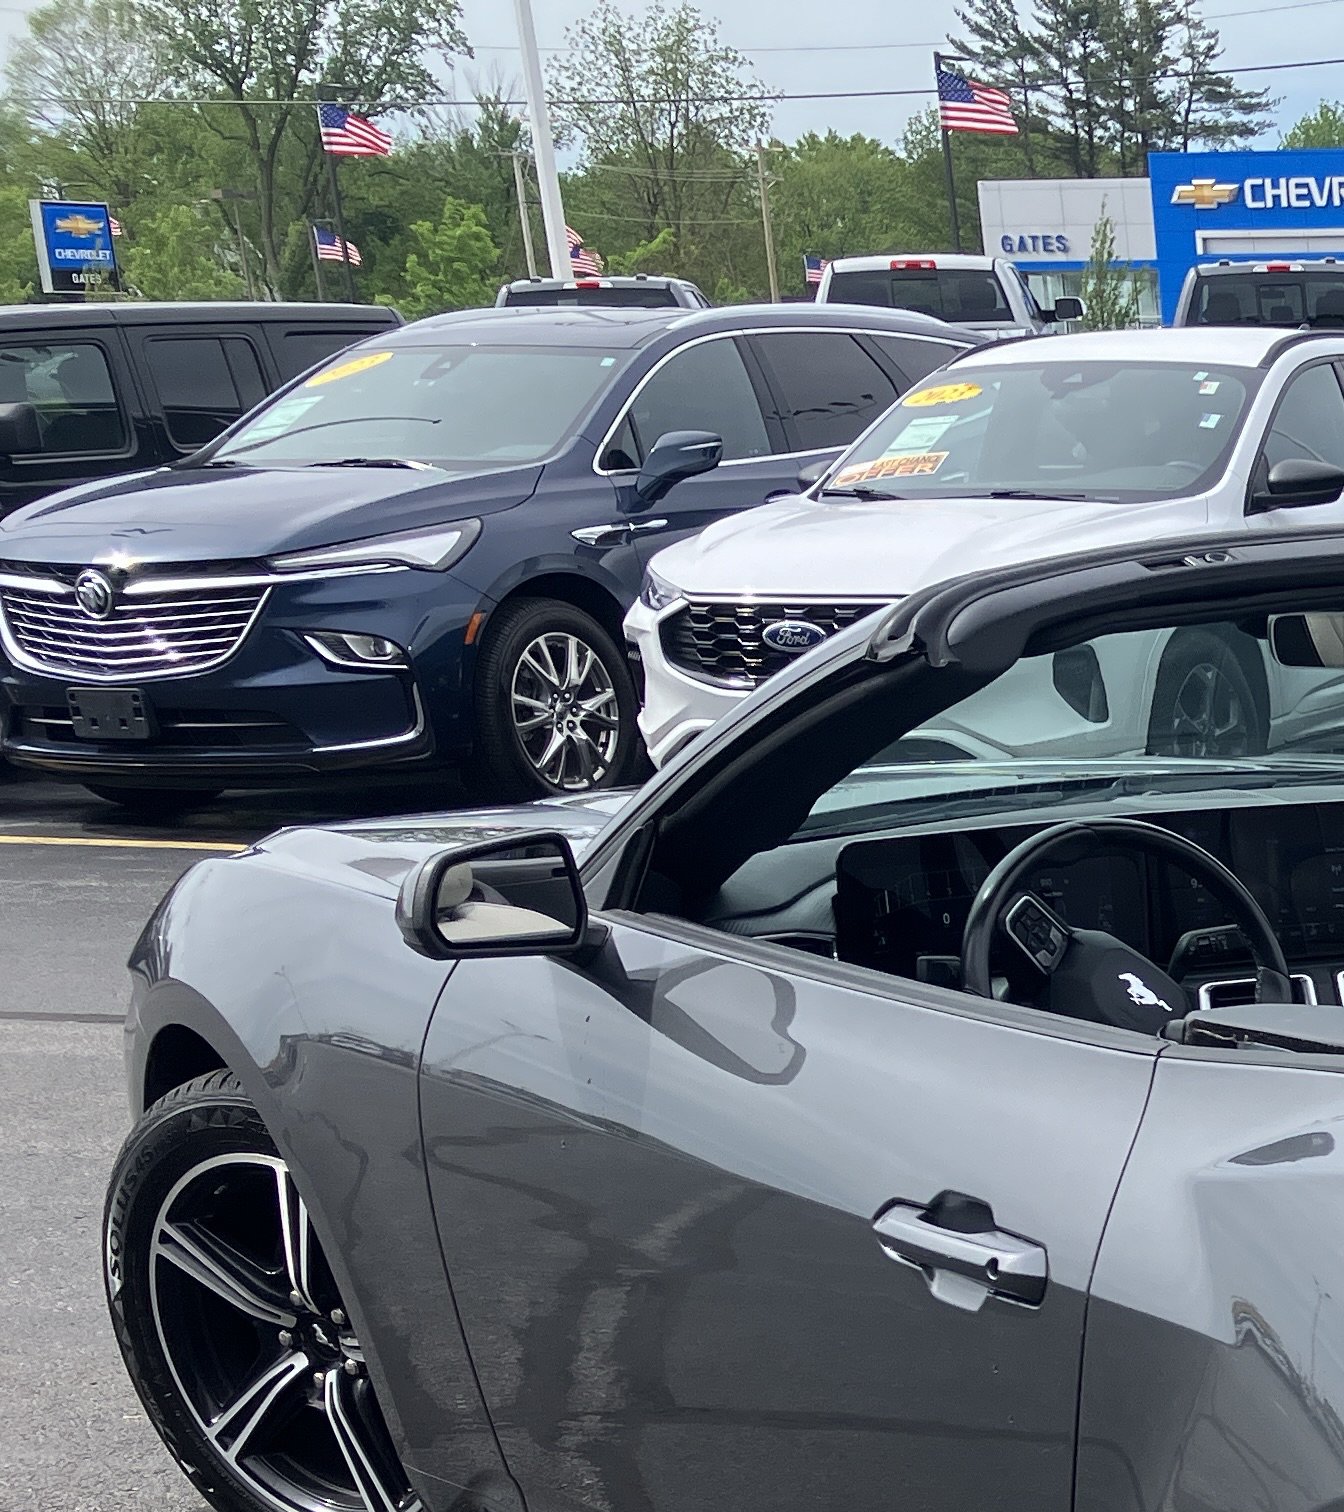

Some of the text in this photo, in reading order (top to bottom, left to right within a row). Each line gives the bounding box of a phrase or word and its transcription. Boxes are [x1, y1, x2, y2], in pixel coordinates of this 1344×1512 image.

[1001, 234, 1070, 254] GATES
[54, 248, 111, 260] CHEVROLET
[71, 272, 102, 284] GATES
[776, 627, 812, 645] Ford
